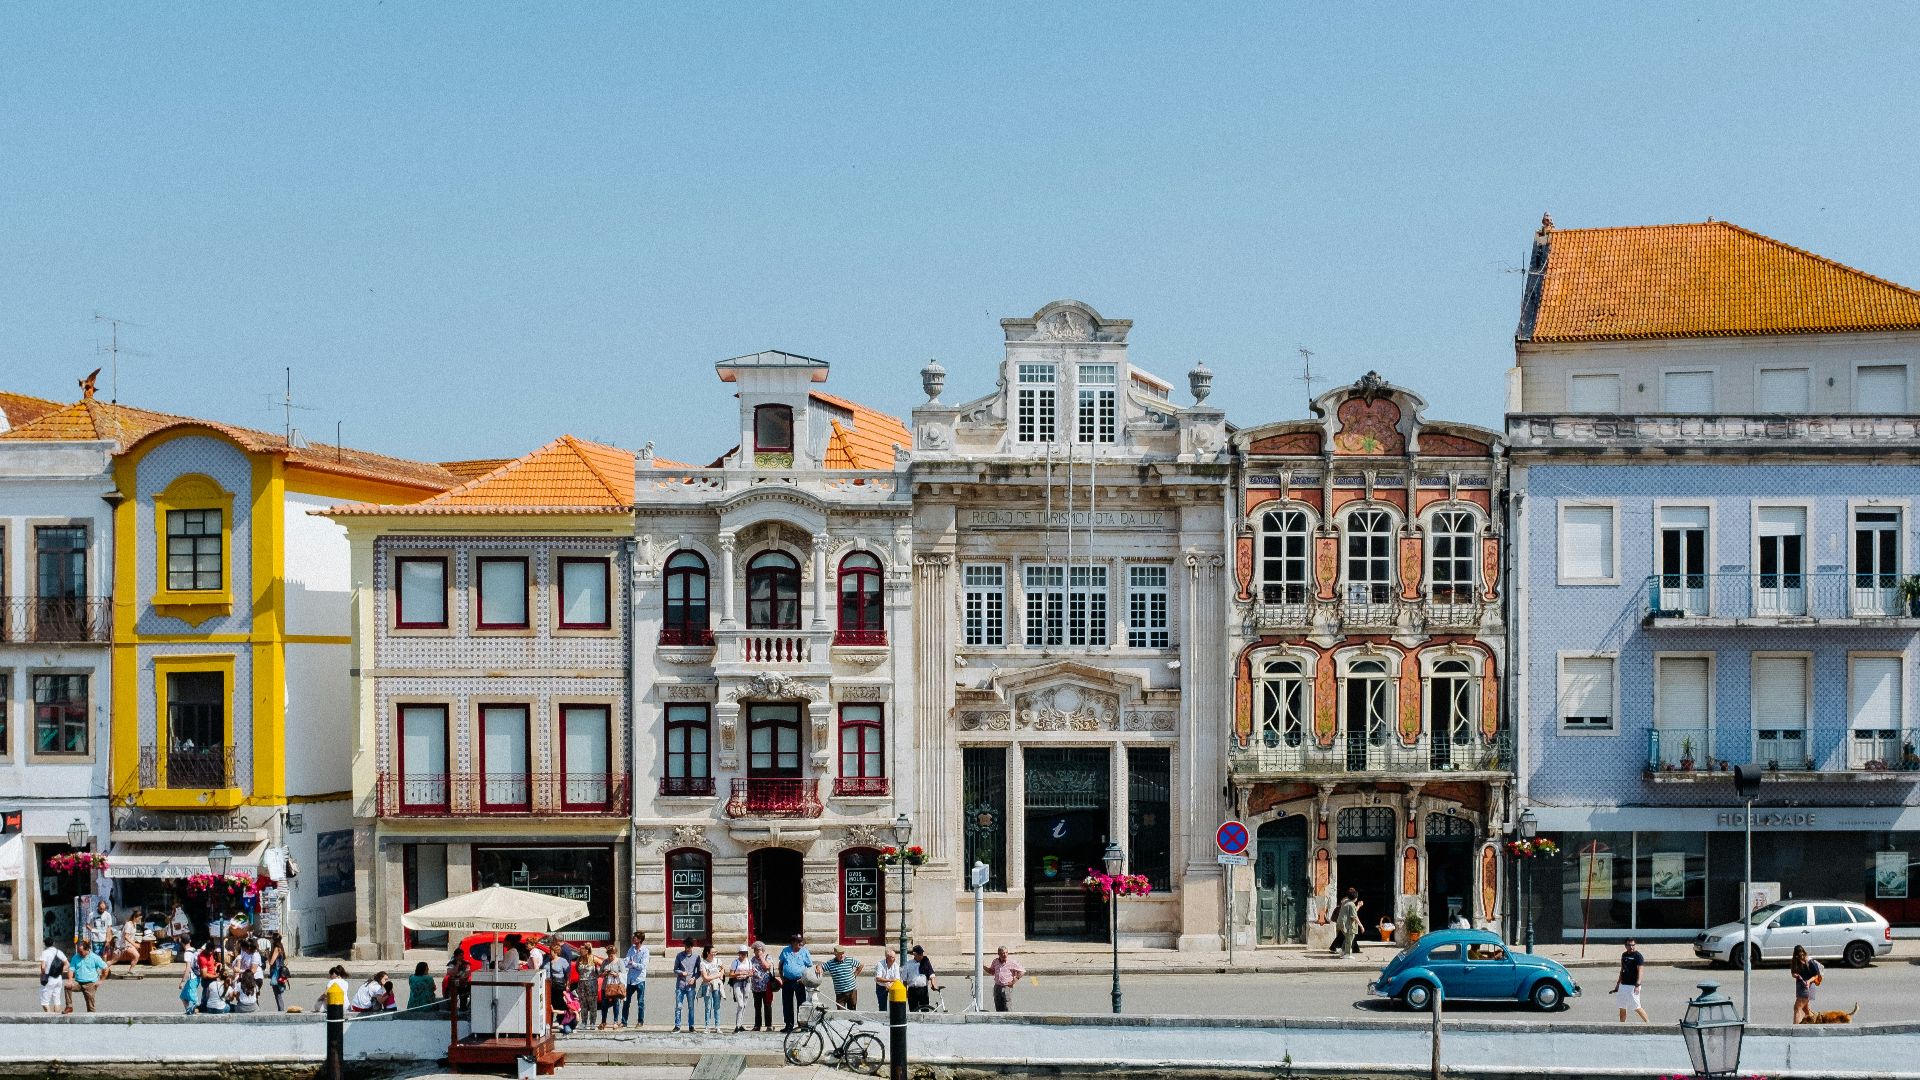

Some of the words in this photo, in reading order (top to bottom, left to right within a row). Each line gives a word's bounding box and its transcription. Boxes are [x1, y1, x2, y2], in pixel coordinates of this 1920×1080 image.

[1016, 511, 1031, 524] DE
[1036, 511, 1084, 524] TURISMO
[1087, 512, 1115, 524] ROTA
[1120, 512, 1136, 524] DA
[1140, 512, 1163, 524] LUZ
[116, 816, 161, 831] CASA
[175, 816, 249, 831] MARQUES
[491, 922, 518, 930] CRUISES
